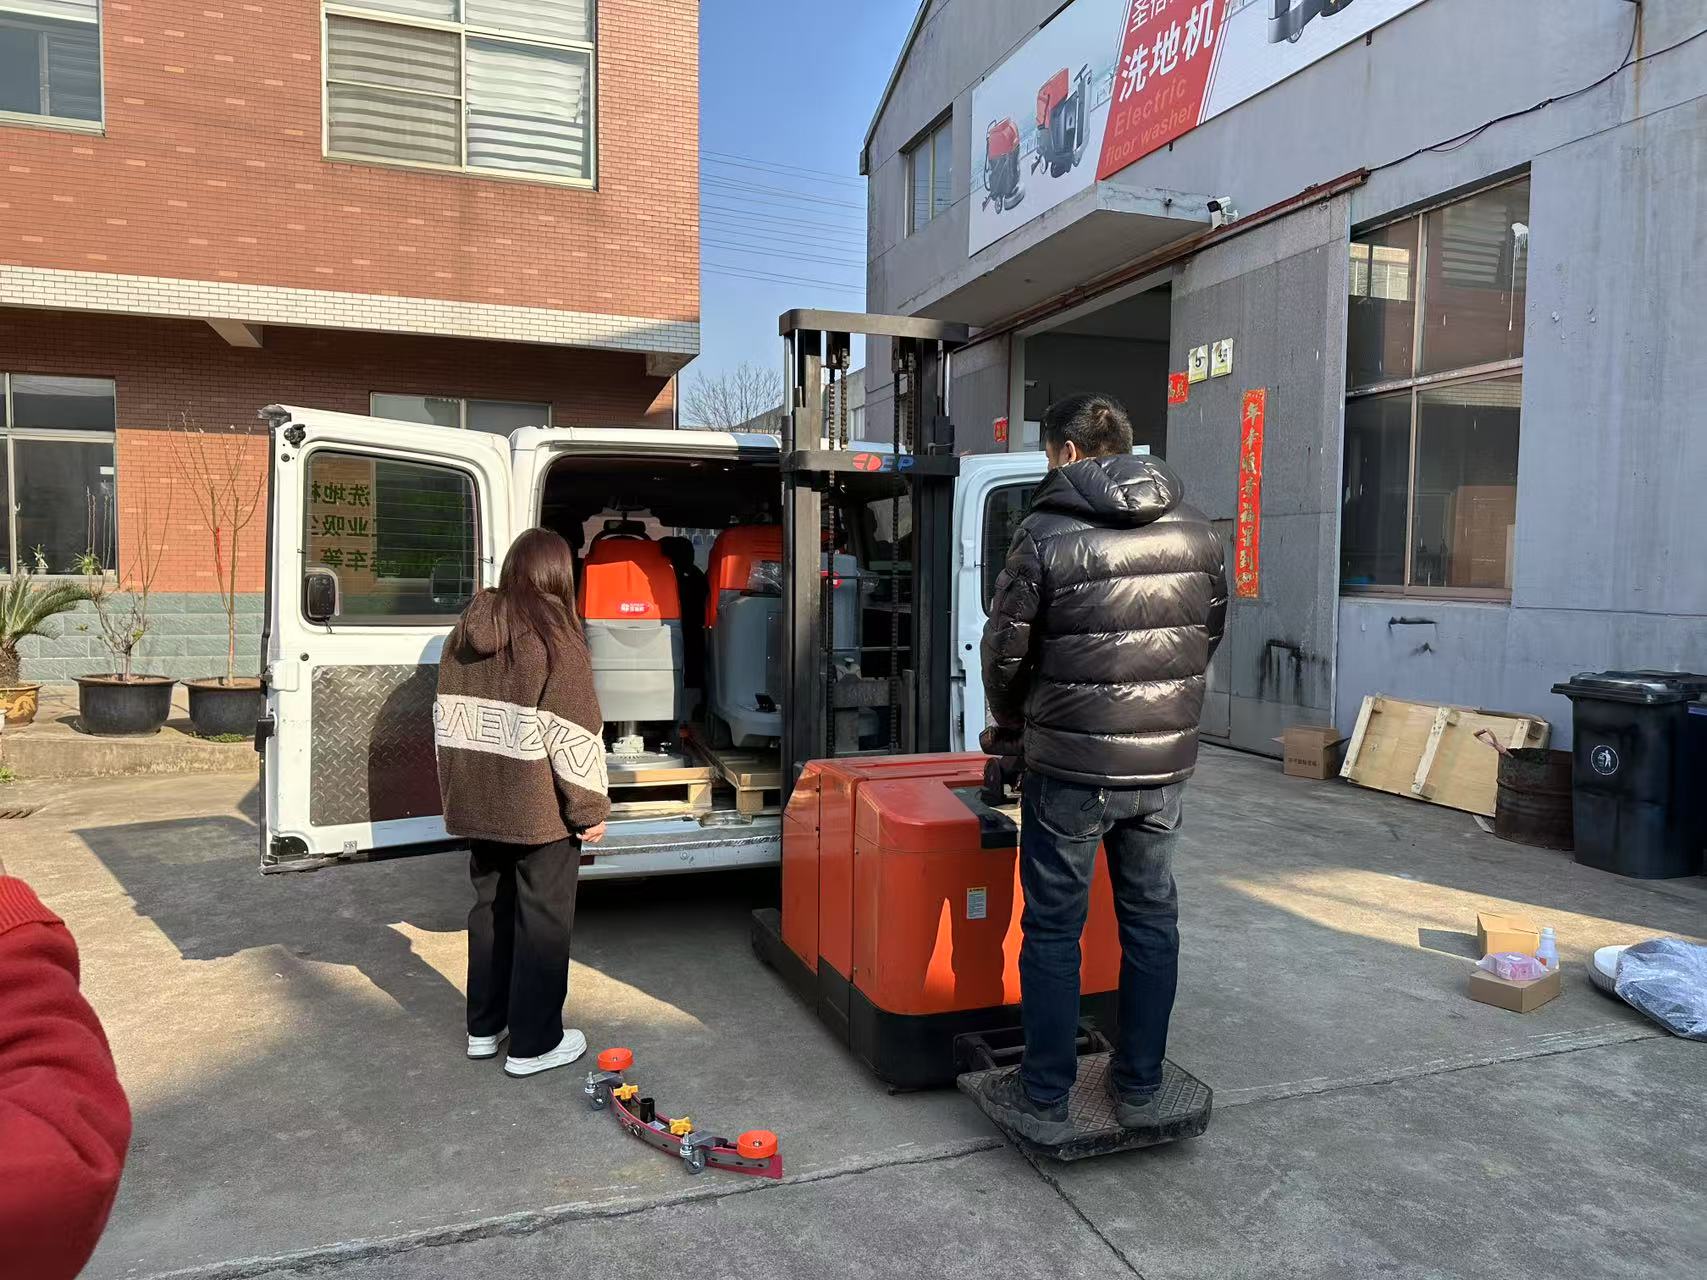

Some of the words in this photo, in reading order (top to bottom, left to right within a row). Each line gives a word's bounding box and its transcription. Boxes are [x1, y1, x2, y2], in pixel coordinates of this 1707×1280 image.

[1119, 0, 1214, 103] 洗地机
[1114, 76, 1187, 138] Electric
[1140, 102, 1196, 147] washer
